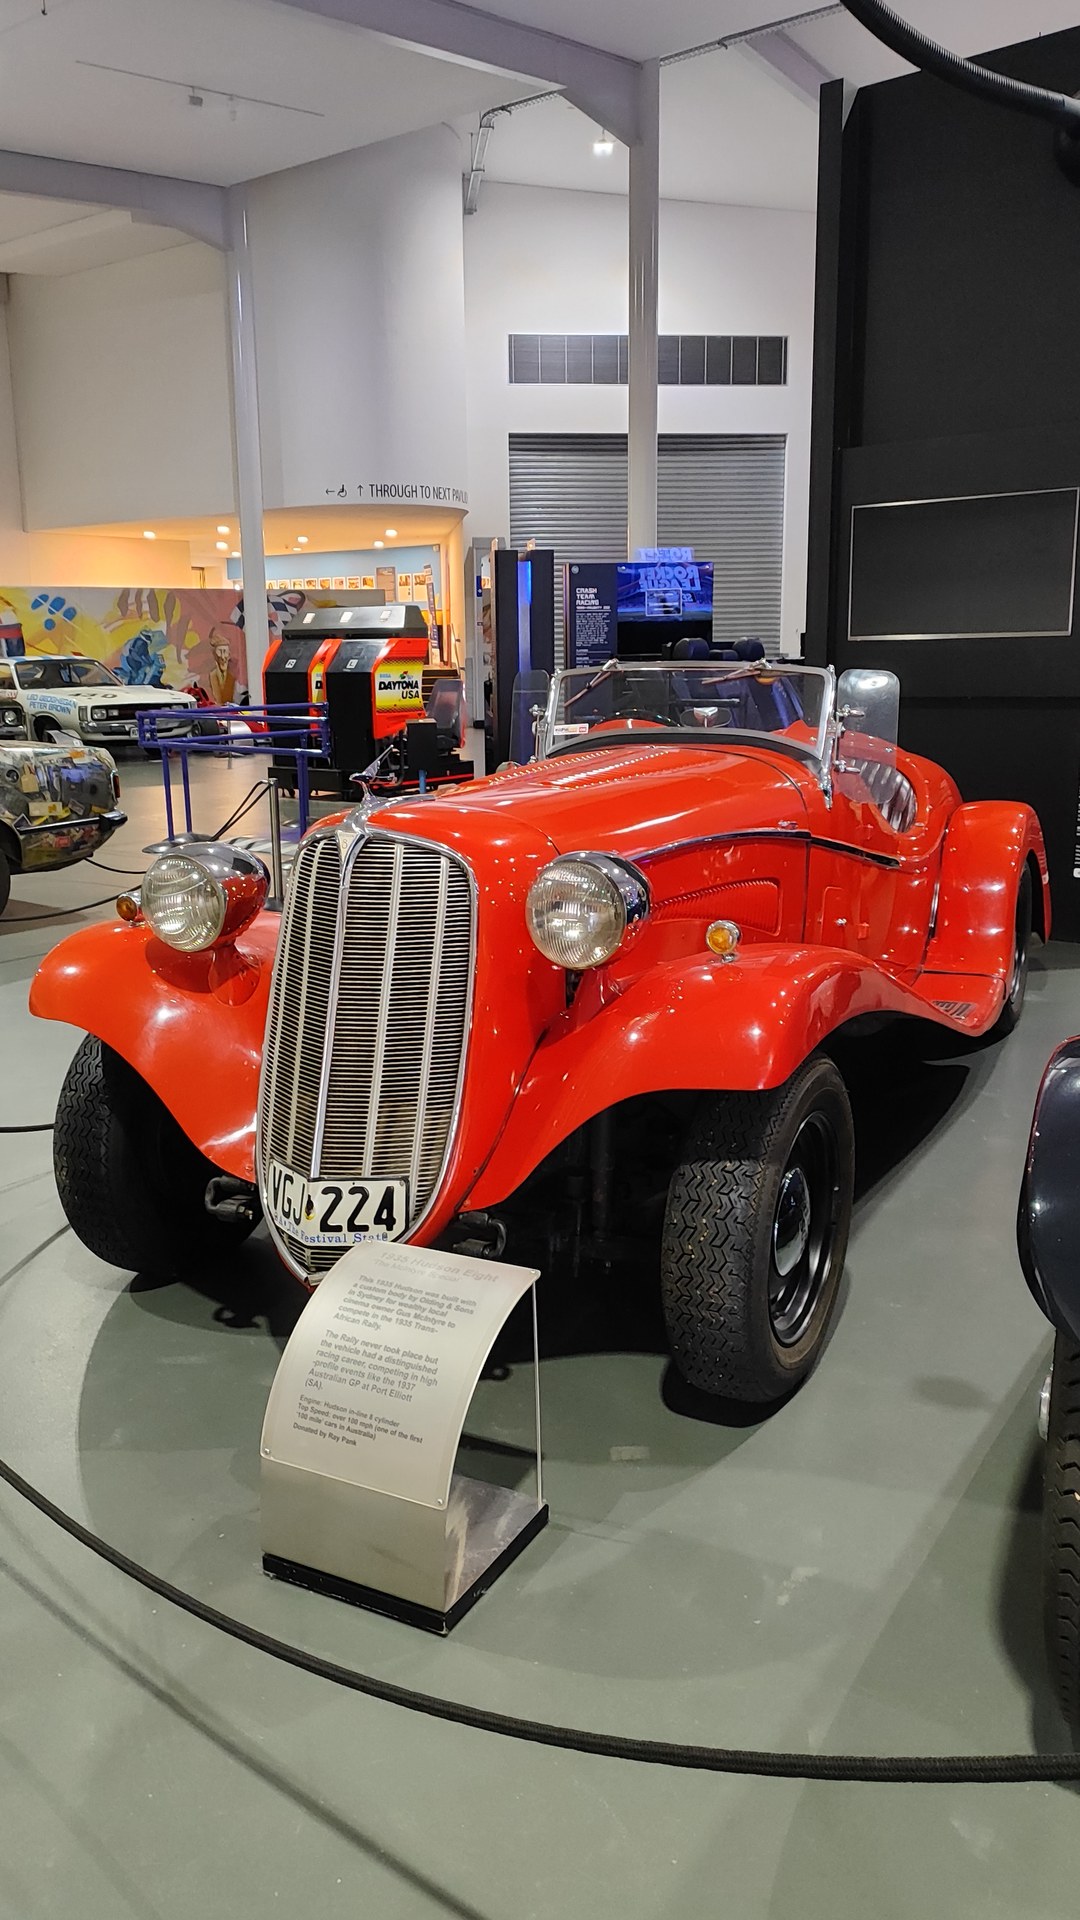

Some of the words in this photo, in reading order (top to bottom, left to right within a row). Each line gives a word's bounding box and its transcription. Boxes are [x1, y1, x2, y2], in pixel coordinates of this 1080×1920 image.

[369, 484, 418, 498] THROUGH
[420, 485, 431, 499] TO
[433, 487, 451, 500] NEXT
[378, 680, 419, 690] DAYTONA
[401, 690, 419, 700] USA
[273, 1165, 305, 1226] VGJ
[320, 1186, 396, 1232] 224
[300, 1230, 347, 1243] Festival
[381, 1252, 406, 1263] 1935
[410, 1258, 461, 1274] Hudson
[462, 1267, 500, 1283] Eight
[357, 1290, 385, 1304] Sydney
[386, 1296, 397, 1305] for
[398, 1302, 428, 1314] wealthy
[428, 1307, 448, 1318] local
[359, 1284, 387, 1295] custom
[388, 1288, 408, 1300] body
[408, 1294, 418, 1303] by
[454, 1305, 474, 1315] Sons
[360, 1275, 374, 1283] This
[376, 1279, 394, 1288] 1935
[394, 1282, 423, 1294] Hudson
[425, 1290, 440, 1298] was
[441, 1293, 460, 1303] built
[460, 1298, 477, 1307] with
[333, 1312, 360, 1325] African
[361, 1318, 382, 1331] Rally.
[338, 1305, 370, 1319] compete
[371, 1311, 380, 1319] in
[380, 1314, 392, 1323] the
[395, 1318, 413, 1328] 1935
[414, 1322, 438, 1334] Trans-
[343, 1297, 370, 1309] cinema
[371, 1303, 395, 1314] owner
[396, 1308, 411, 1318] Gus
[413, 1312, 446, 1327] McIntyre
[447, 1321, 456, 1329] to
[320, 1339, 333, 1348] the
[334, 1343, 361, 1356] vehicle
[362, 1350, 378, 1360] had
[384, 1355, 438, 1376] distinguished
[325, 1329, 339, 1340] The
[340, 1333, 360, 1346] Rally
[360, 1340, 382, 1350] never
[383, 1344, 400, 1356] took
[401, 1350, 424, 1362] place
[424, 1355, 439, 1366] but
[312, 1360, 339, 1372] -profile
[340, 1366, 366, 1378] events
[366, 1371, 382, 1382] like
[382, 1376, 396, 1386] the
[398, 1380, 416, 1392] 1937
[316, 1349, 340, 1362] racing
[341, 1356, 366, 1369] career,
[368, 1362, 410, 1380] competing
[410, 1372, 419, 1381] in
[420, 1375, 438, 1388] high
[304, 1378, 323, 1391] (SA).
[308, 1368, 347, 1385] Australian
[348, 1378, 361, 1388] GP
[362, 1382, 370, 1391] at
[370, 1384, 388, 1396] Port
[388, 1389, 413, 1402] Elliott
[298, 1402, 309, 1412] Top
[310, 1406, 330, 1418] Speed:
[332, 1413, 346, 1422] over
[348, 1417, 358, 1426] 100
[359, 1421, 374, 1430] mph
[374, 1424, 388, 1434] (one
[398, 1432, 408, 1440] the
[409, 1434, 423, 1444] first
[299, 1394, 322, 1406] Engine:
[323, 1400, 348, 1413] Hudson
[348, 1408, 368, 1419] in-line
[374, 1416, 400, 1428] cylinder
[292, 1422, 318, 1435] Donated
[319, 1428, 328, 1438] by
[328, 1432, 340, 1443] Ray
[341, 1436, 357, 1446] Pank
[324, 1420, 338, 1429] cars
[346, 1425, 376, 1440] Australia)
